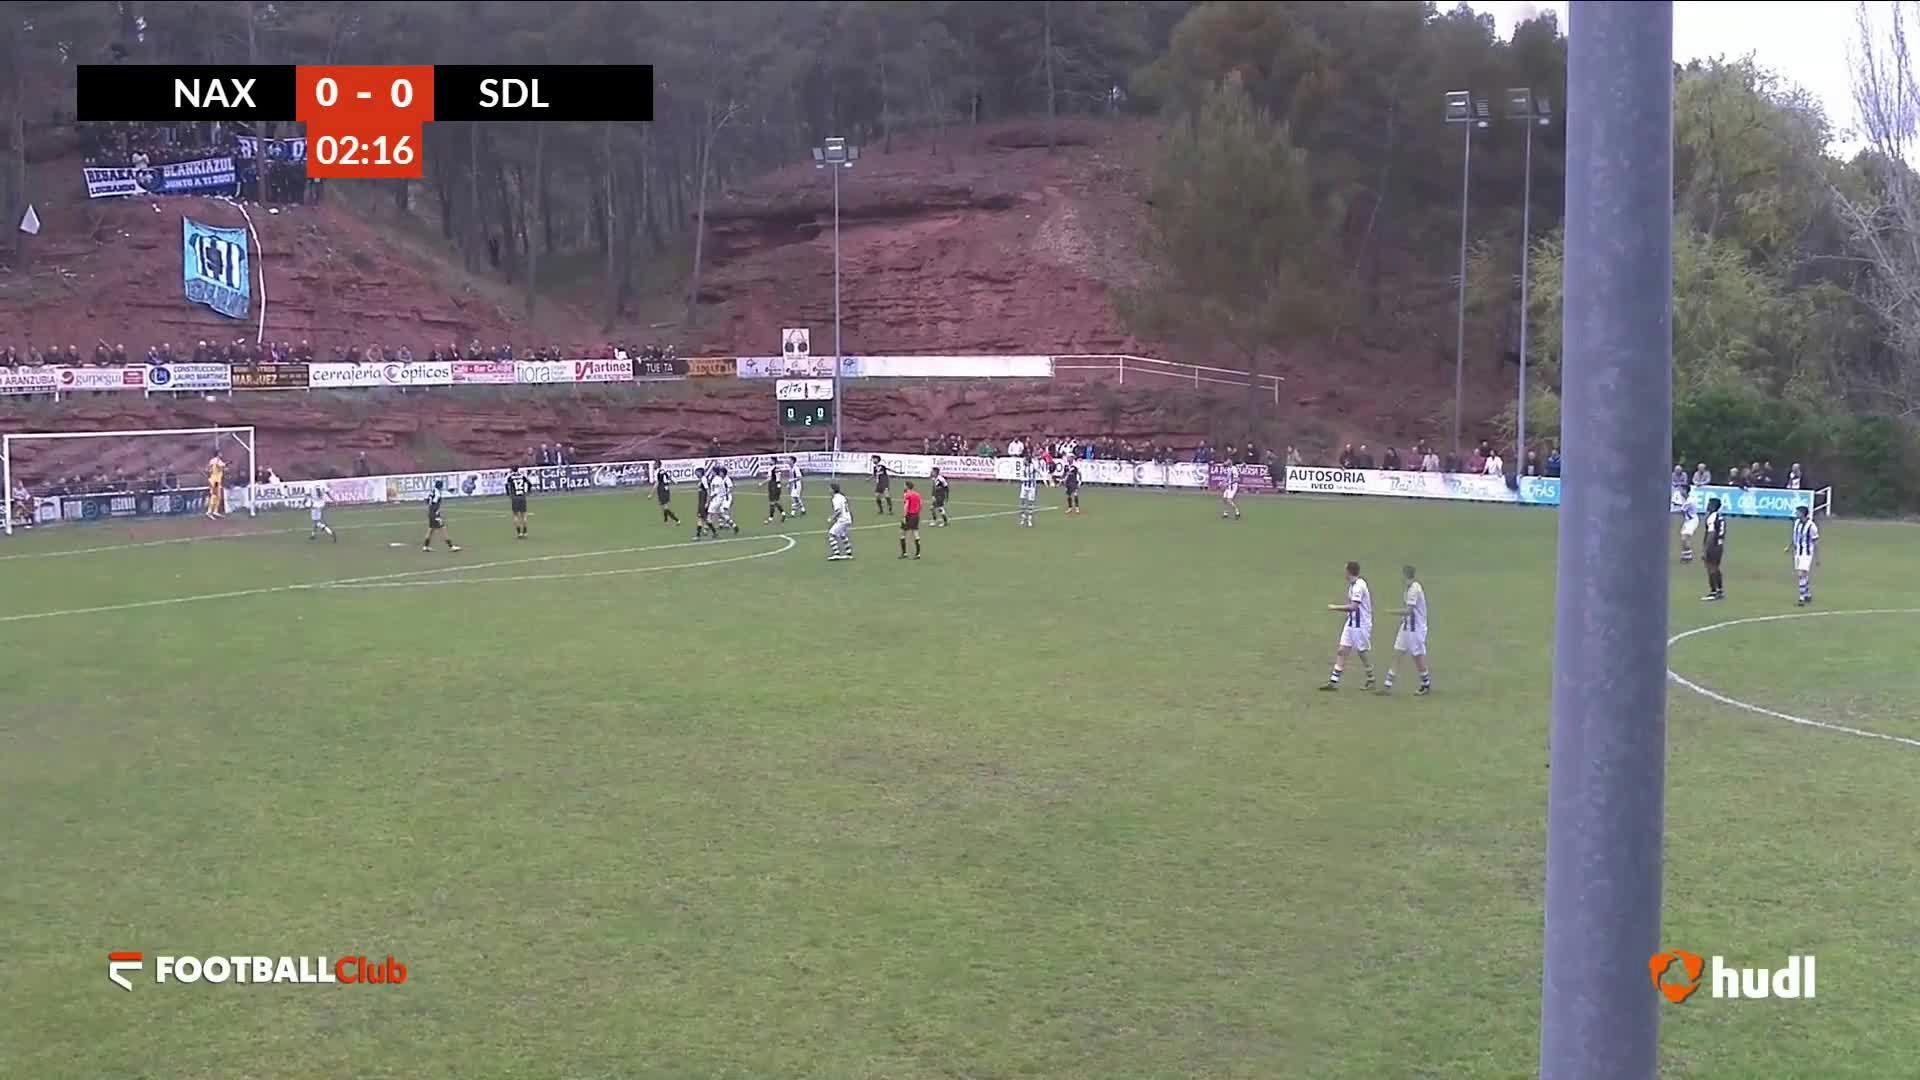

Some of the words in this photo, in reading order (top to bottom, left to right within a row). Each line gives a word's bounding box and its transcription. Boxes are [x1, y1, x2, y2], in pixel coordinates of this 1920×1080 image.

[165, 178, 193, 188] JUNTO
[194, 177, 202, 186] A
[4, 375, 56, 385] ARANZUBIA
[787, 408, 794, 418] 0
[817, 408, 824, 417] 0
[805, 416, 812, 425] 2
[959, 458, 995, 467] NORMAN
[1289, 469, 1366, 484] AUTOSORIA
[542, 478, 557, 490] La
[560, 477, 590, 489] Plaza
